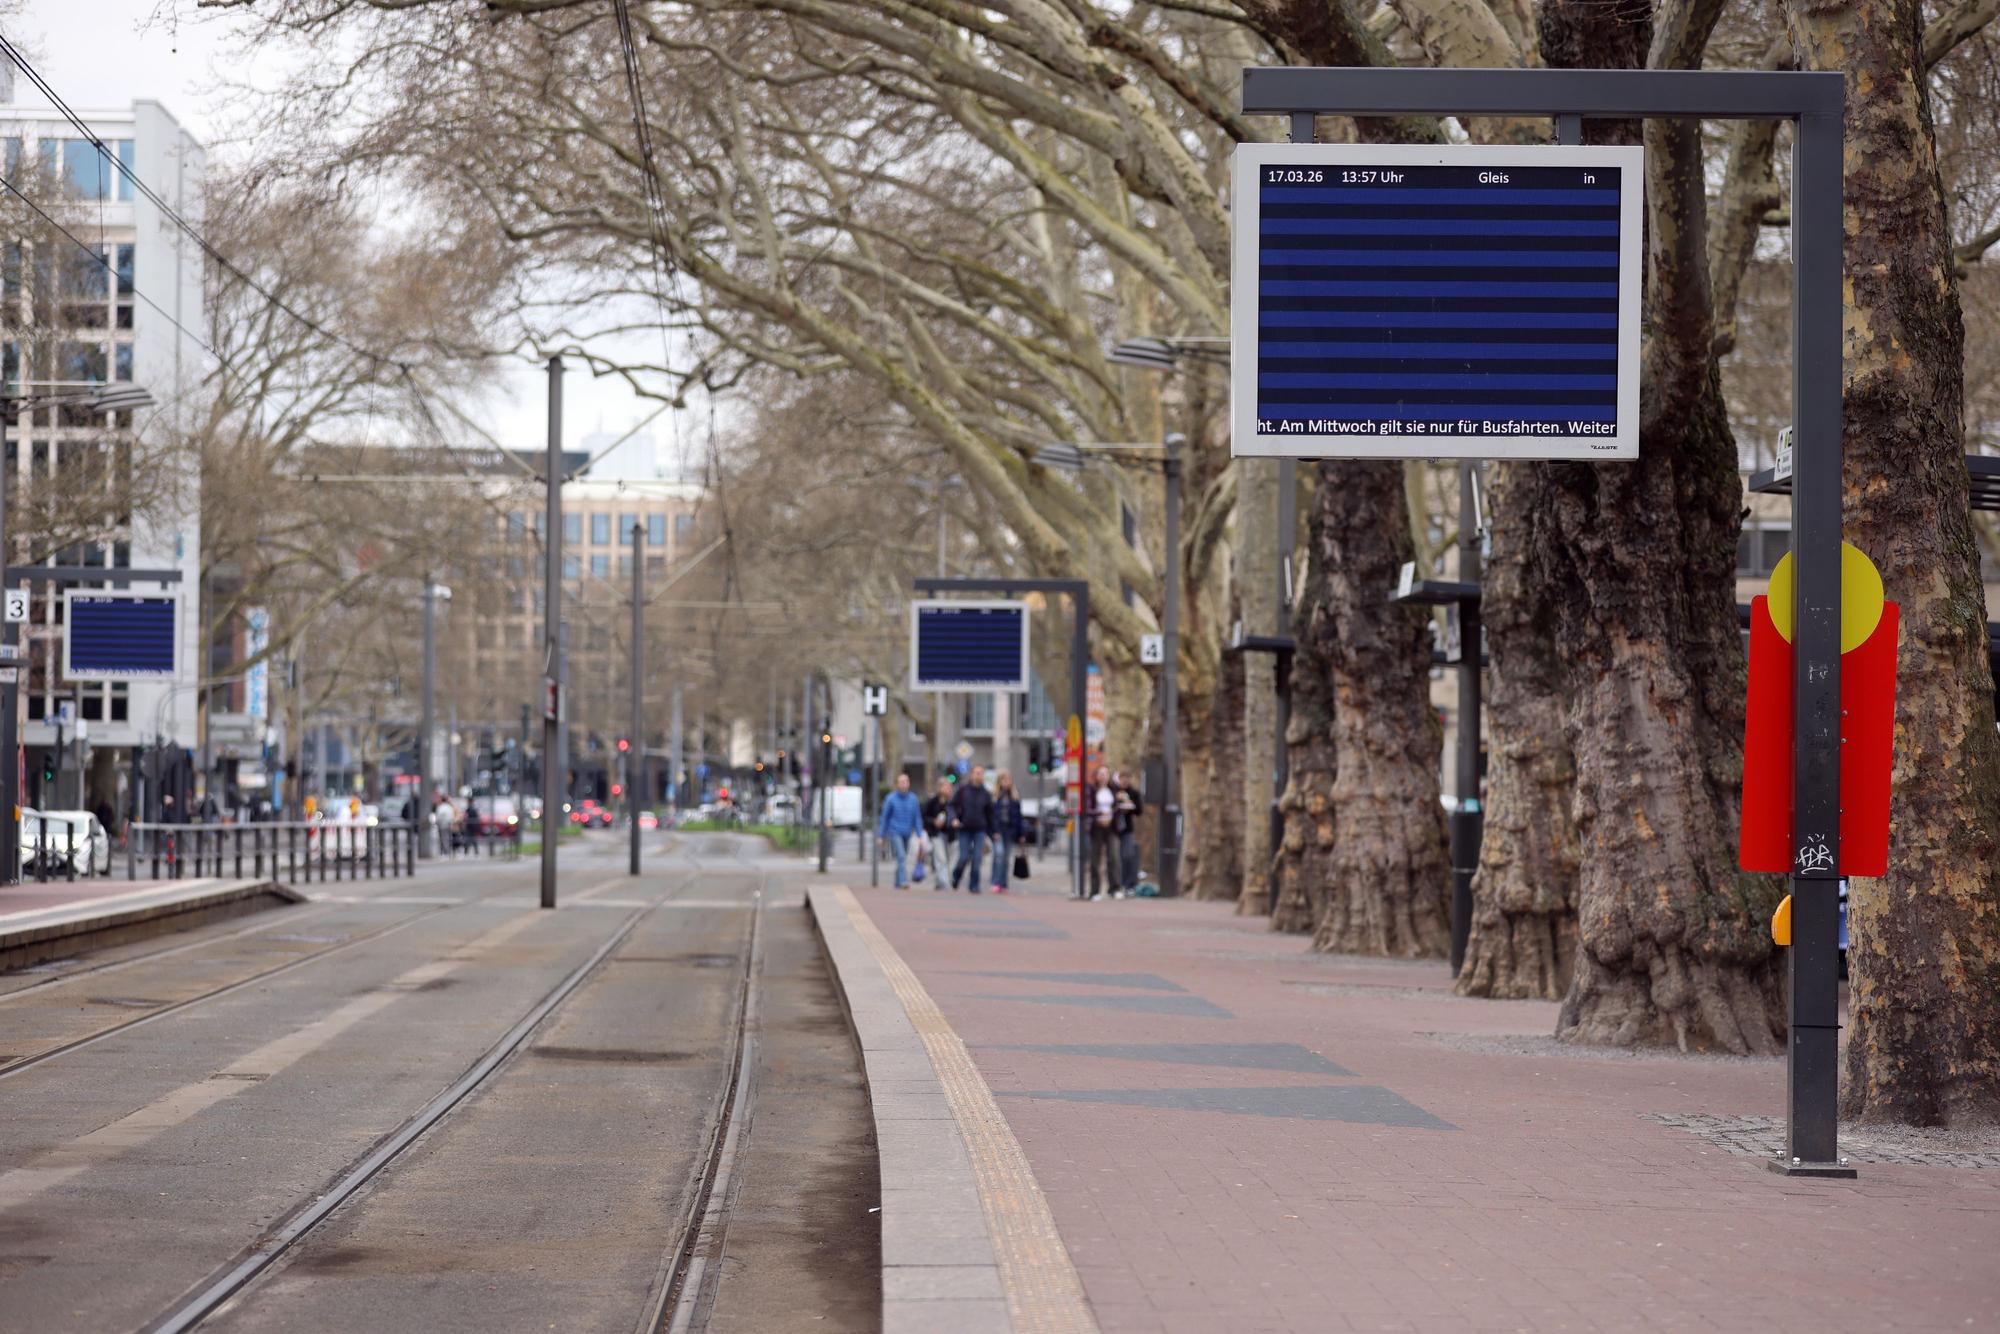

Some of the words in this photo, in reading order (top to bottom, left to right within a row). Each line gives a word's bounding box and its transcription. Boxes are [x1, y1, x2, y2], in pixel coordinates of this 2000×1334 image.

[1268, 170, 1324, 183] 17.03.26
[1342, 171, 1377, 183] 13:57
[1380, 170, 1405, 183] Uhr
[1478, 171, 1510, 184] Gleis
[1583, 172, 1596, 184] in
[1279, 419, 1304, 433] Am
[1308, 419, 1376, 433] Mittwoch
[1379, 419, 1402, 435] gilt
[1406, 420, 1426, 434] sie
[1429, 422, 1454, 434] nur
[1458, 419, 1479, 434] für
[1482, 419, 1564, 434] Busfahrten.
[1567, 420, 1615, 434] Weiter
[10, 600, 24, 617] 3
[1146, 642, 1158, 658] 4
[865, 686, 887, 714] H
